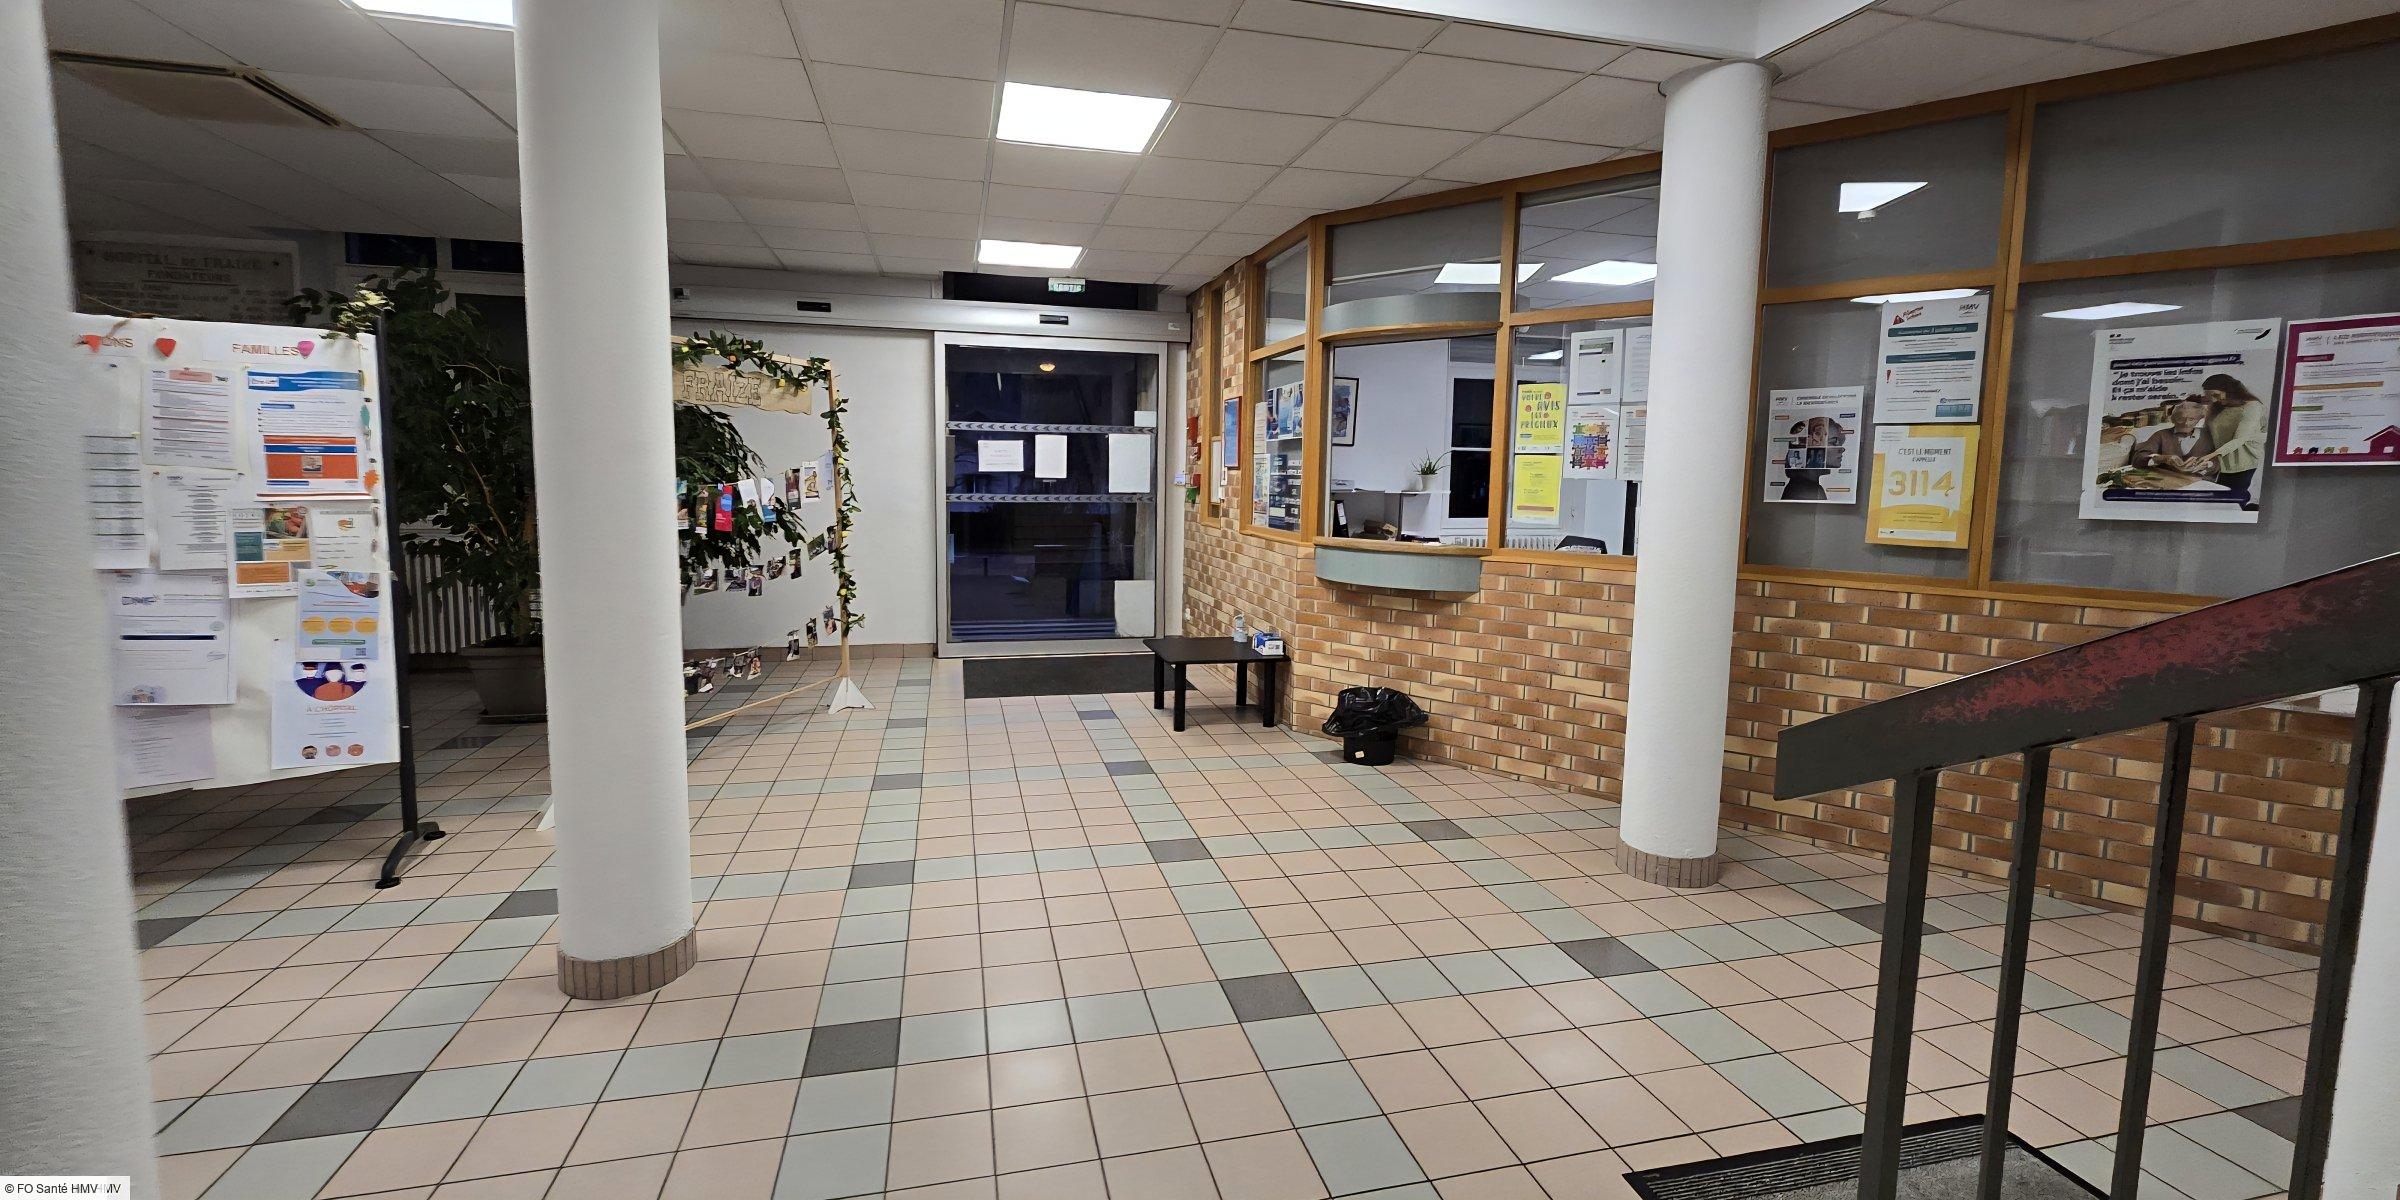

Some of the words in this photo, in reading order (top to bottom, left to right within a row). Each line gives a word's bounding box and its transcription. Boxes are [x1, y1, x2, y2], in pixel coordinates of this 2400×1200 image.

[232, 343, 299, 356] FAMILLES
[681, 369, 762, 406] FRAIZE
[1537, 401, 1561, 411] AVIS
[1888, 469, 1953, 497] 3114
